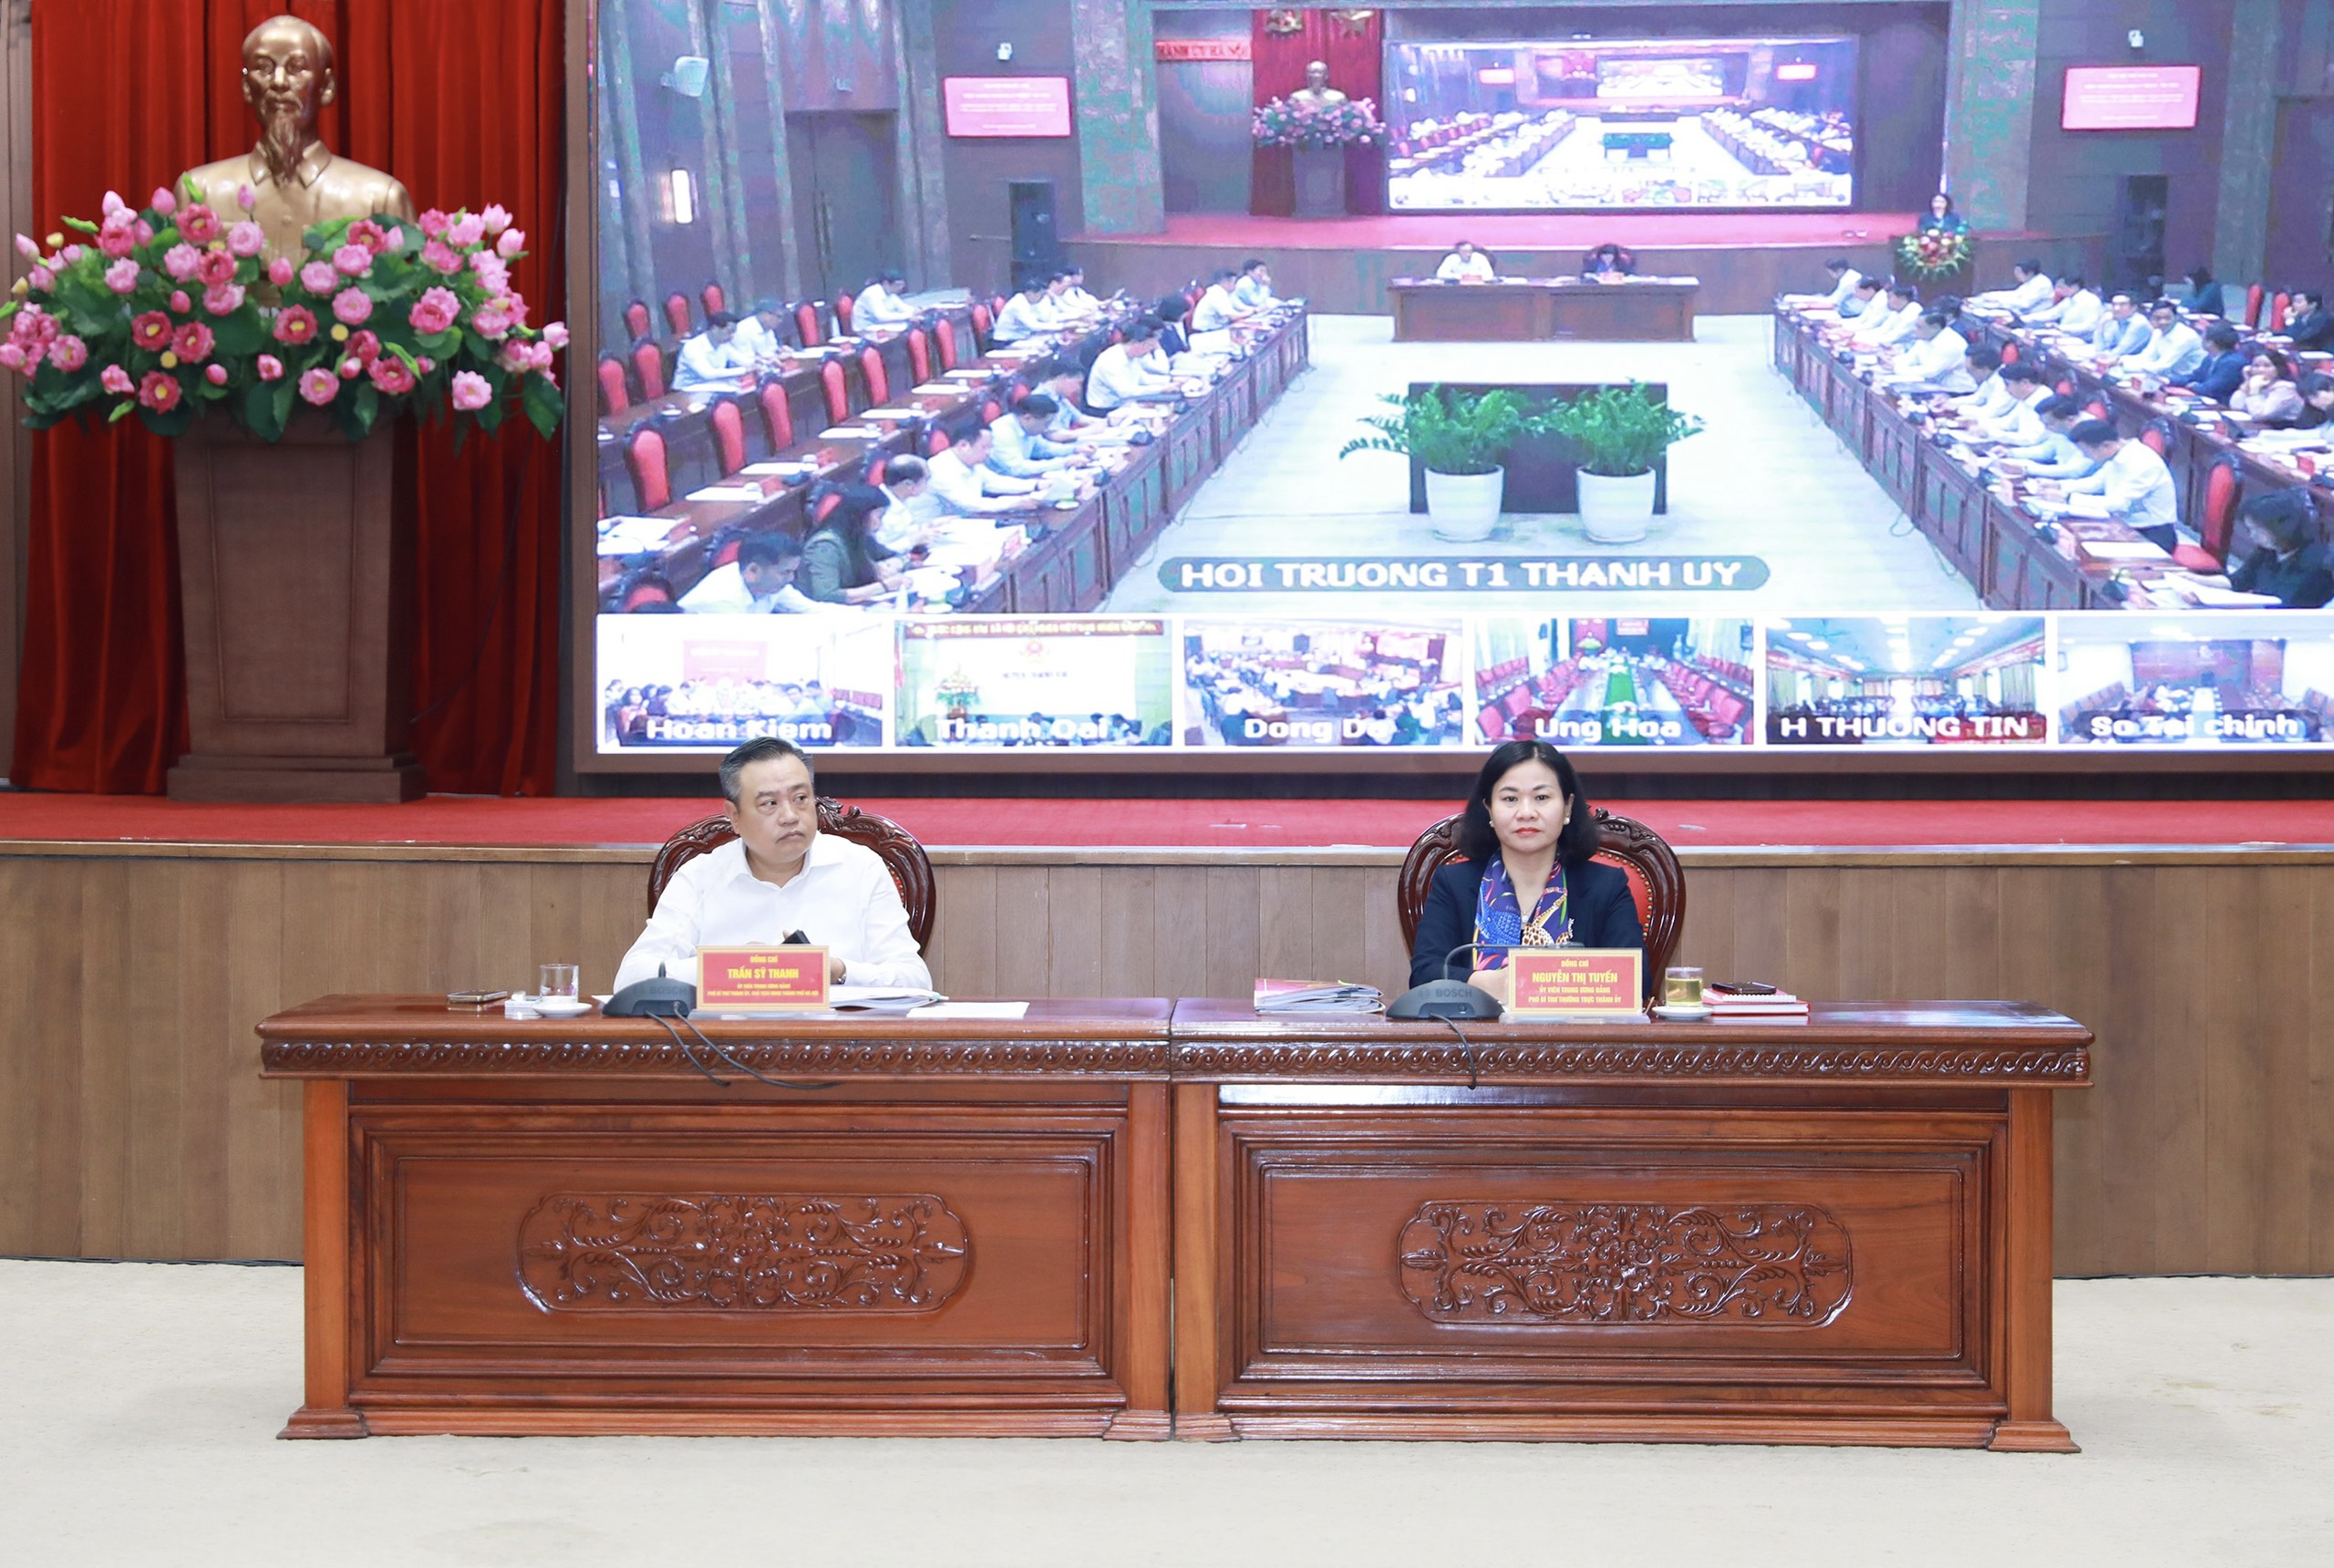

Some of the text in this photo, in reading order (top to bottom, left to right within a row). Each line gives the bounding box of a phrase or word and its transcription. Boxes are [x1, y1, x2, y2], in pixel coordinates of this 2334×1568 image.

[1182, 562, 1741, 587] HOI TRUONG T1 THANH UY
[646, 717, 833, 739] Hoan Kiem
[935, 717, 1042, 739] Thanh
[1244, 718, 1333, 743] Dong
[1534, 717, 1681, 743] Ung Hoa
[1781, 717, 2028, 738] H THUONG TIN
[2091, 716, 2133, 737] So
[2204, 714, 2299, 738] chinh
[768, 968, 800, 979] THANH
[1571, 972, 1585, 985] THỊ
[649, 985, 687, 995] BOSCH
[1436, 988, 1472, 998] BOSCH
